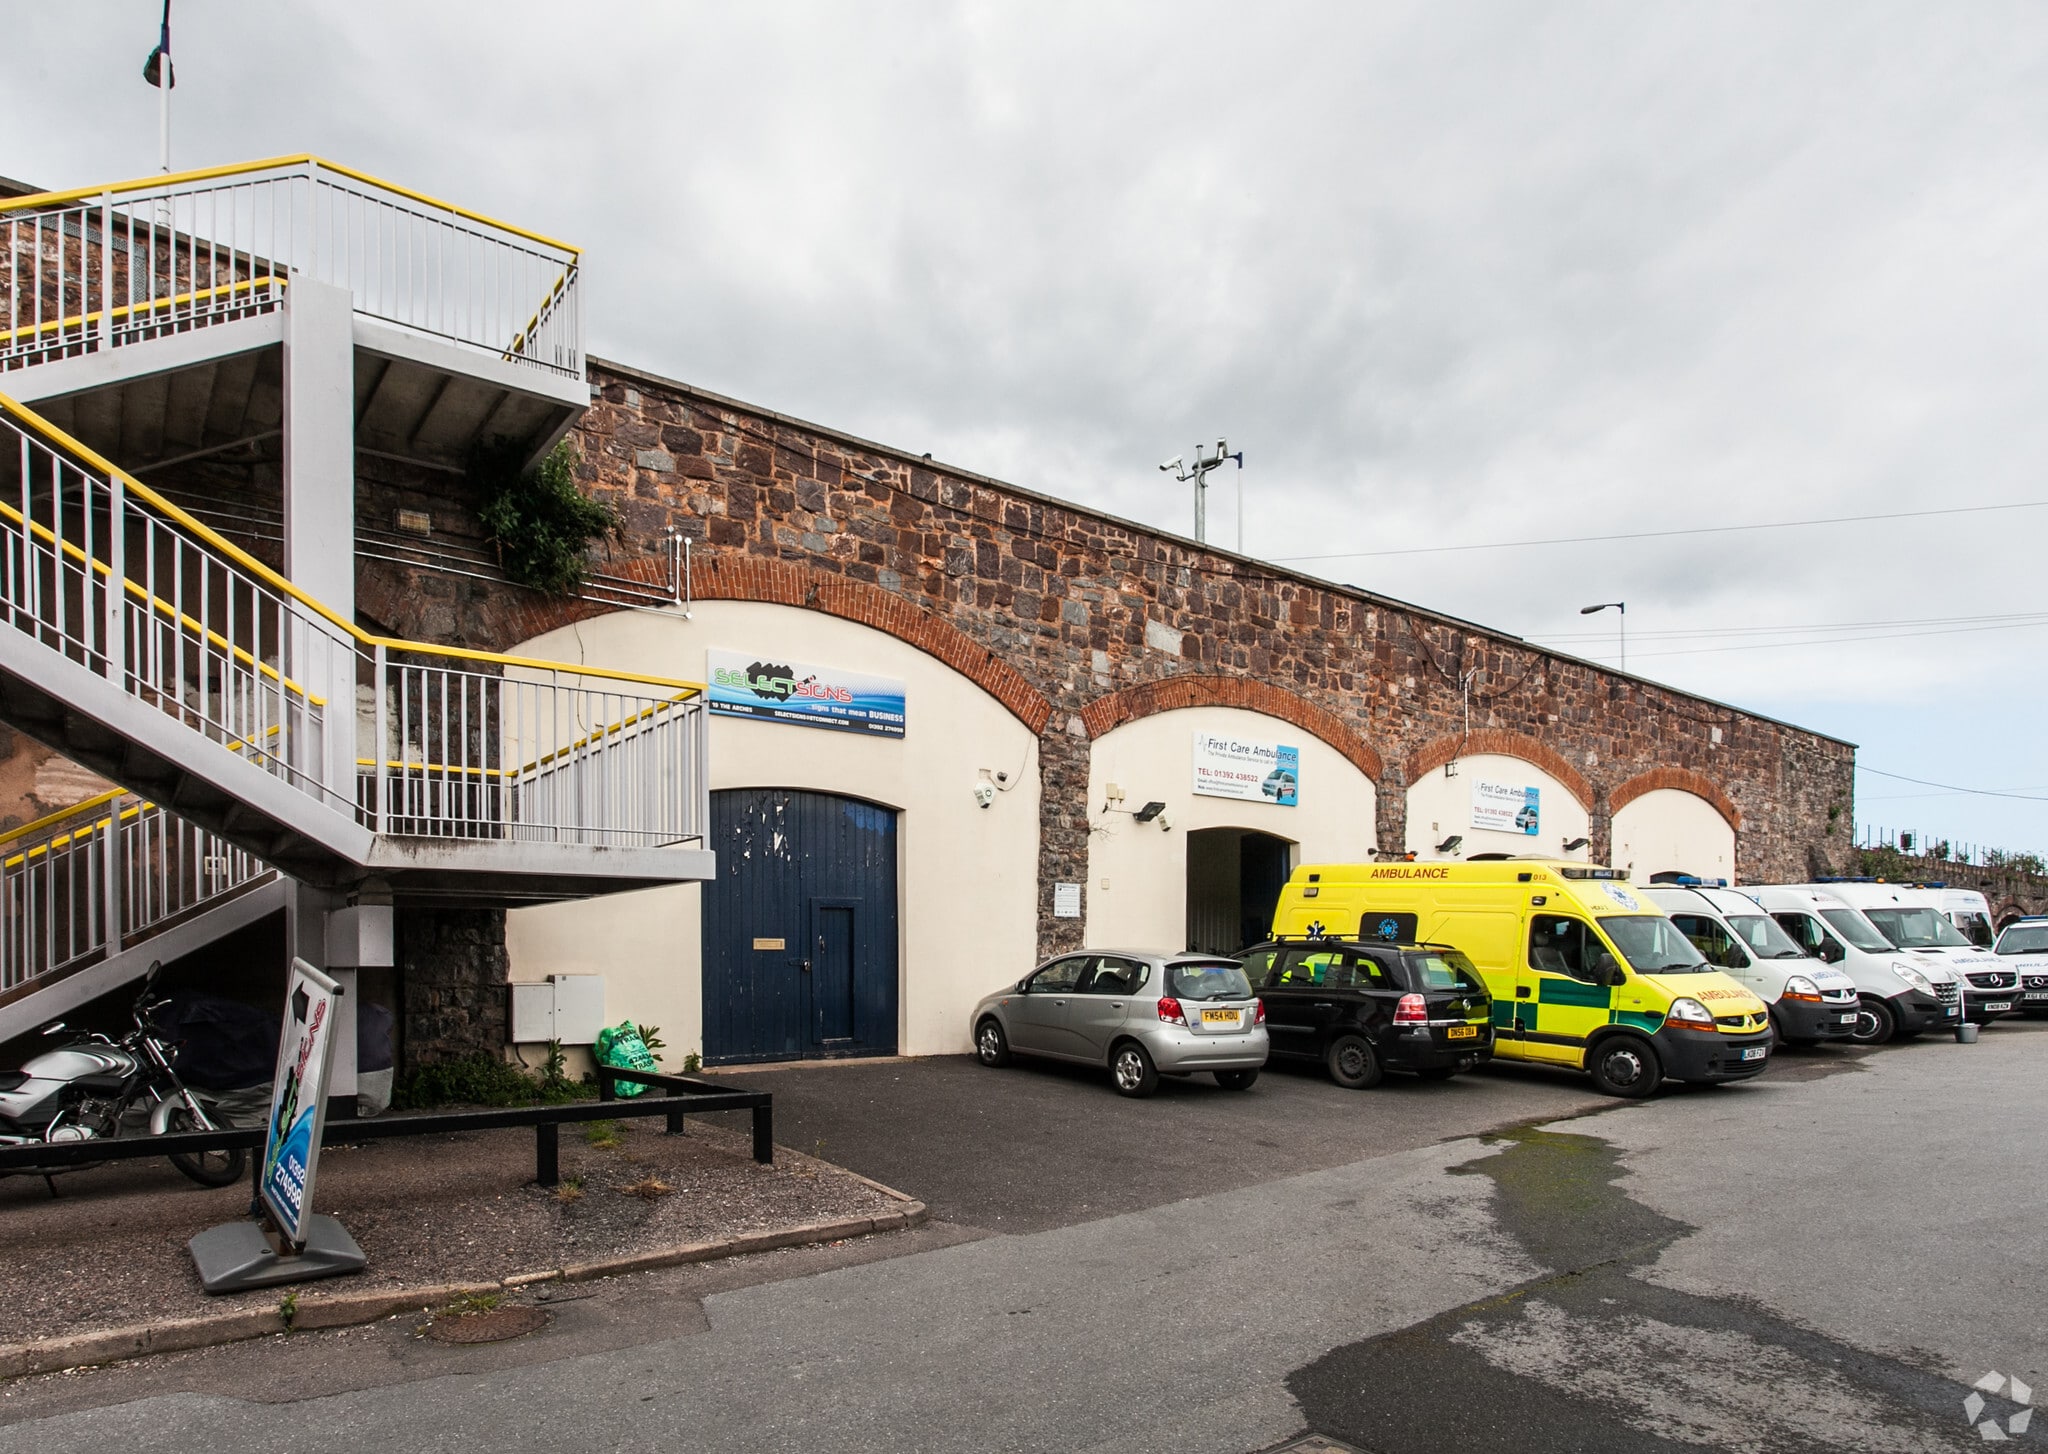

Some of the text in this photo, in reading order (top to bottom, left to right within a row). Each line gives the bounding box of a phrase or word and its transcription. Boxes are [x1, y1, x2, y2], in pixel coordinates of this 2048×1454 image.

[732, 704, 753, 713] ARCHES
[831, 706, 846, 715] that
[848, 709, 867, 717] mean
[869, 710, 904, 723] BUSINESS
[1208, 738, 1297, 761] First Care Ambulance
[1198, 767, 1259, 782] TEL: 01392 438522
[1481, 783, 1493, 793] First
[1495, 785, 1508, 795] Care
[1510, 788, 1538, 799] Ambulance
[1371, 868, 1450, 879] AMBULANCE
[1204, 1011, 1223, 1021] FM54
[289, 1154, 306, 1185] 01392
[275, 1161, 302, 1210] 274998
